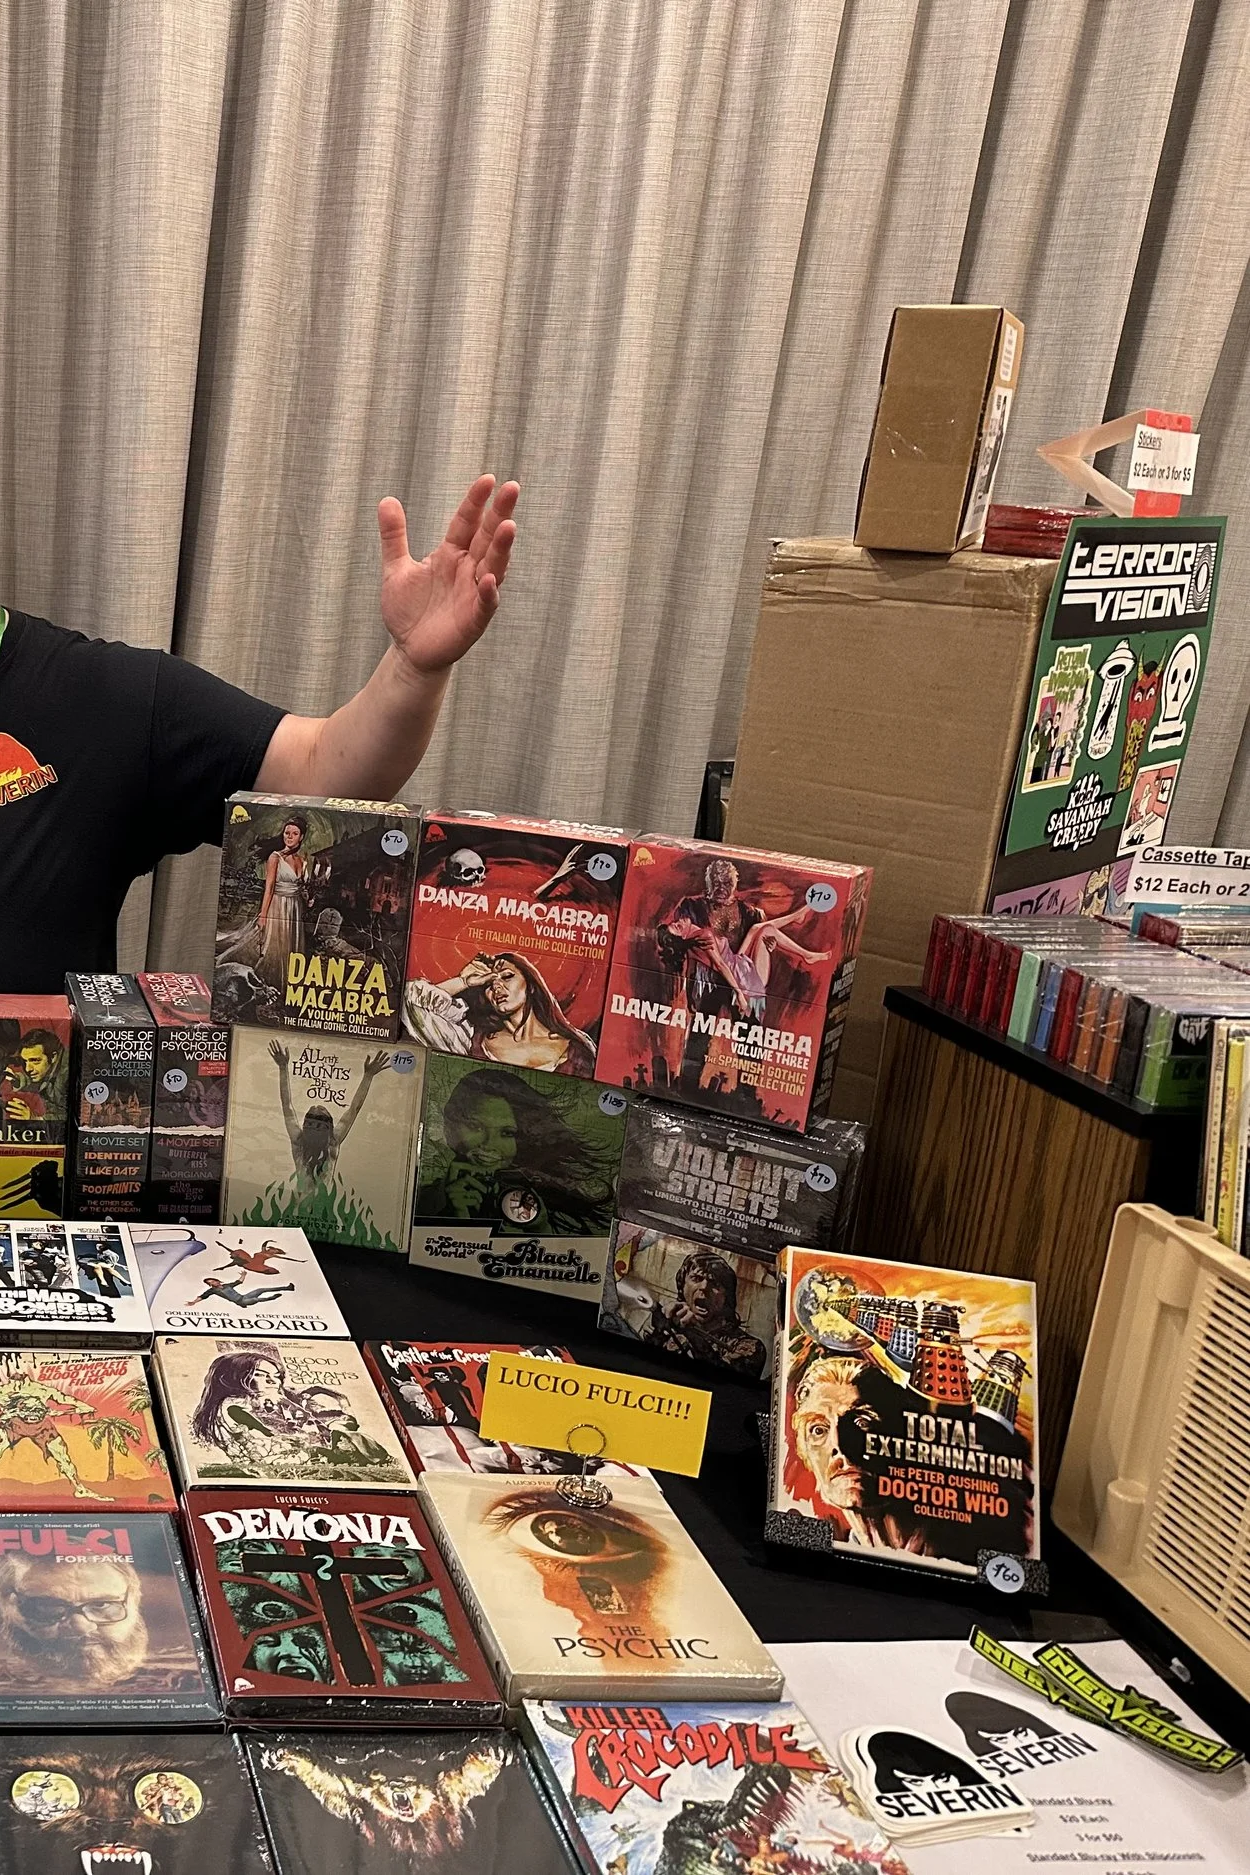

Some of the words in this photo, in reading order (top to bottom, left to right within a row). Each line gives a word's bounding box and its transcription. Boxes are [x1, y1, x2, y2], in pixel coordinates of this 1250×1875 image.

[1138, 430, 1162, 448] Stickers
[1133, 462, 1141, 477] $2
[1142, 463, 1156, 478] Each
[1158, 468, 1165, 479] or
[1171, 466, 1181, 480] for
[1183, 467, 1191, 481] $5
[1068, 783, 1101, 810] KEEP
[1047, 797, 1113, 833] SAVANNAH
[1053, 818, 1102, 849] CREEPY
[1141, 847, 1217, 865] Cassette
[808, 889, 831, 903] $70
[1134, 876, 1163, 892] $12
[1167, 879, 1211, 895] Each
[1216, 884, 1236, 896] or
[1238, 883, 1250, 897] 2
[418, 884, 489, 914] DANZA
[495, 897, 610, 933] MACABRA
[468, 927, 484, 940] THE
[485, 930, 517, 945] ITALIAN
[519, 934, 550, 951] GOTHIC
[551, 941, 605, 960] COLLECTION
[535, 925, 577, 941] VOLUME
[581, 931, 607, 946] TWO
[287, 952, 388, 995] DANZA
[284, 985, 396, 1018] MACABRA
[307, 1008, 346, 1022] VOLUME
[348, 1013, 368, 1025] ONE
[610, 993, 688, 1029] DANZA
[692, 1012, 812, 1058] MACABRA
[87, 1041, 153, 1051] PSYCHOTIC
[96, 1030, 135, 1041] HOUSE
[137, 1030, 154, 1041] OF
[110, 1050, 153, 1061] WOMEN
[392, 1055, 414, 1065] $175
[730, 1042, 774, 1063] VOLUME
[775, 1052, 809, 1070] THREE
[291, 1062, 351, 1081] HAUNTS
[740, 1072, 806, 1097] COLLECTION
[306, 1086, 349, 1108] OURS
[84, 1151, 143, 1161] IDENTIKIT
[652, 1137, 806, 1203] VIOLENT
[82, 1181, 142, 1195] FOOTPRINTS
[666, 1170, 780, 1220] STREETS
[690, 1208, 749, 1229] COLLECTION
[508, 1237, 583, 1267] Black
[478, 1253, 601, 1284] Emanuelle
[27, 1288, 80, 1303] MAD
[166, 1316, 329, 1333] OVERBOARD
[40, 1365, 63, 1374] THE
[65, 1360, 129, 1372] COMPLETE
[283, 1356, 339, 1366] BLOOD
[37, 1371, 79, 1381] BLOOD
[84, 1368, 128, 1378] ISLAND
[69, 1376, 105, 1387] FILMS
[498, 1366, 580, 1397] LUCIO
[585, 1385, 692, 1421] FULCI!!!
[903, 1410, 984, 1451] TOTAL
[865, 1433, 1023, 1481] EXTERMINATION
[888, 1465, 906, 1478] THE
[907, 1466, 945, 1485] PETER
[948, 1473, 999, 1494] CUSHING
[274, 1495, 298, 1505] LUCIO
[299, 1495, 330, 1505] FULCI'S
[878, 1475, 958, 1510] DOCTOR
[964, 1491, 1009, 1518] WHO
[913, 1504, 972, 1524] COLLECTION
[198, 1508, 427, 1552] DEMONIA
[55, 1555, 90, 1564] FOR
[92, 1555, 135, 1563] FAKE
[992, 1562, 1020, 1584] $60
[604, 1625, 646, 1637] THE
[551, 1636, 719, 1661] PSYCHIC
[1038, 1648, 1222, 1762] INTERVISION
[565, 1707, 668, 1730] KILLER
[976, 1732, 1099, 1779] SEVERIN
[571, 1721, 831, 1814] CROCODILE
[876, 1783, 1024, 1818] SEVERIN
